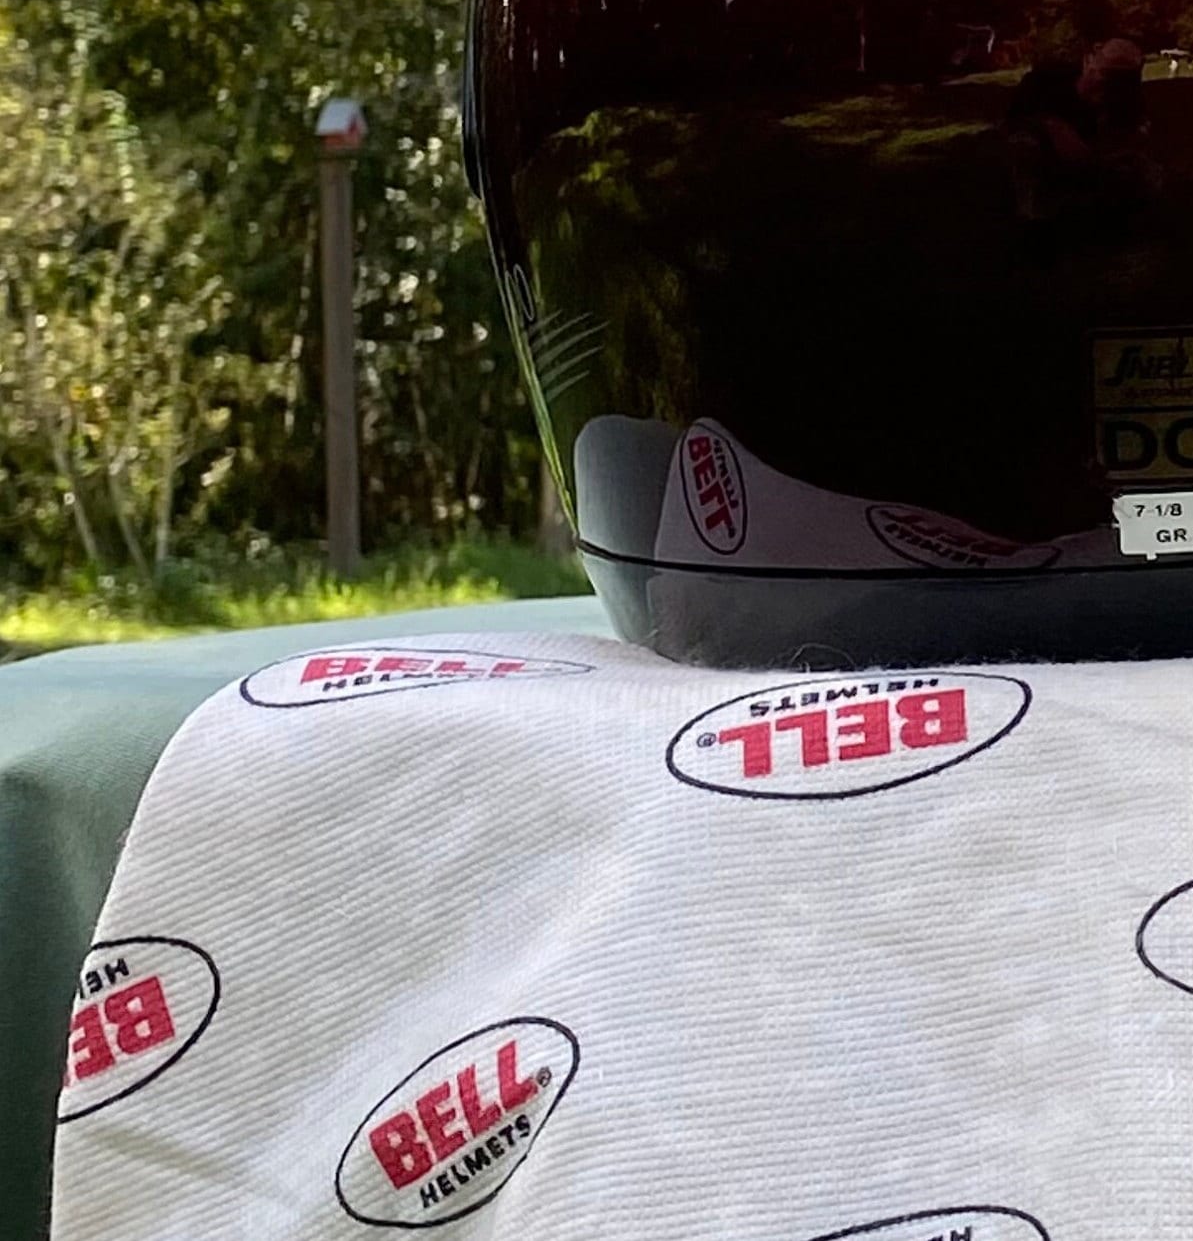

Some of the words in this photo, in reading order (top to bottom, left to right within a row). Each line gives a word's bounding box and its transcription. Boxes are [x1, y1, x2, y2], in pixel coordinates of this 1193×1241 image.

[1155, 528, 1188, 544] GR
[718, 689, 968, 779] BELL
[750, 678, 939, 718] HELMETS
[64, 975, 176, 1087] BE
[368, 1039, 540, 1191] BELL
[419, 1115, 533, 1210] HELMETS
